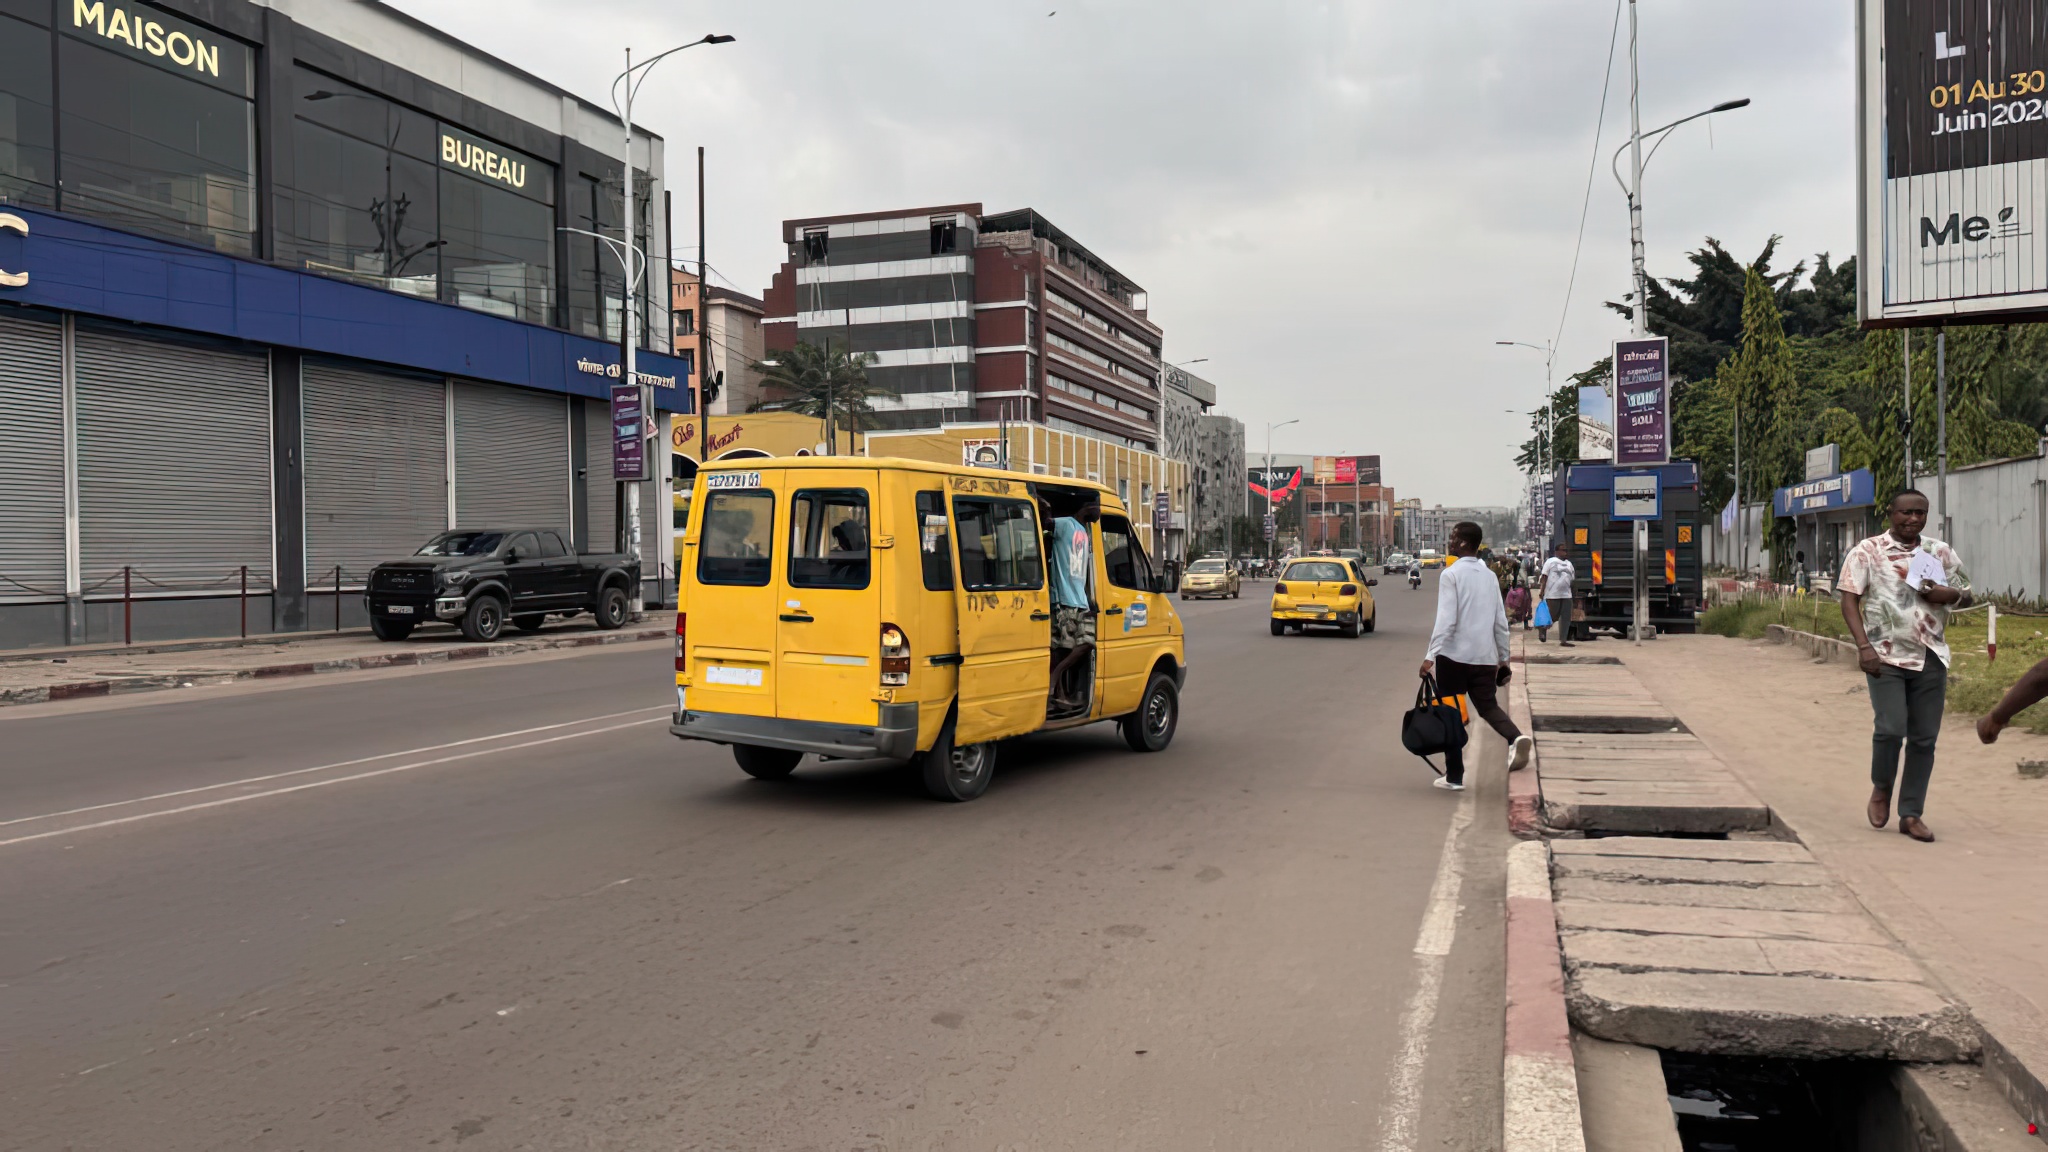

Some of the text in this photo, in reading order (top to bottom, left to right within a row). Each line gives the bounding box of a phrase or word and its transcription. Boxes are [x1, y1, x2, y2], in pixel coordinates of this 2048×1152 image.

[73, 0, 219, 77] MAISON
[1930, 70, 2046, 108] 01 Au 30
[1931, 109, 1987, 135] Juin
[442, 134, 525, 188] BUREAU
